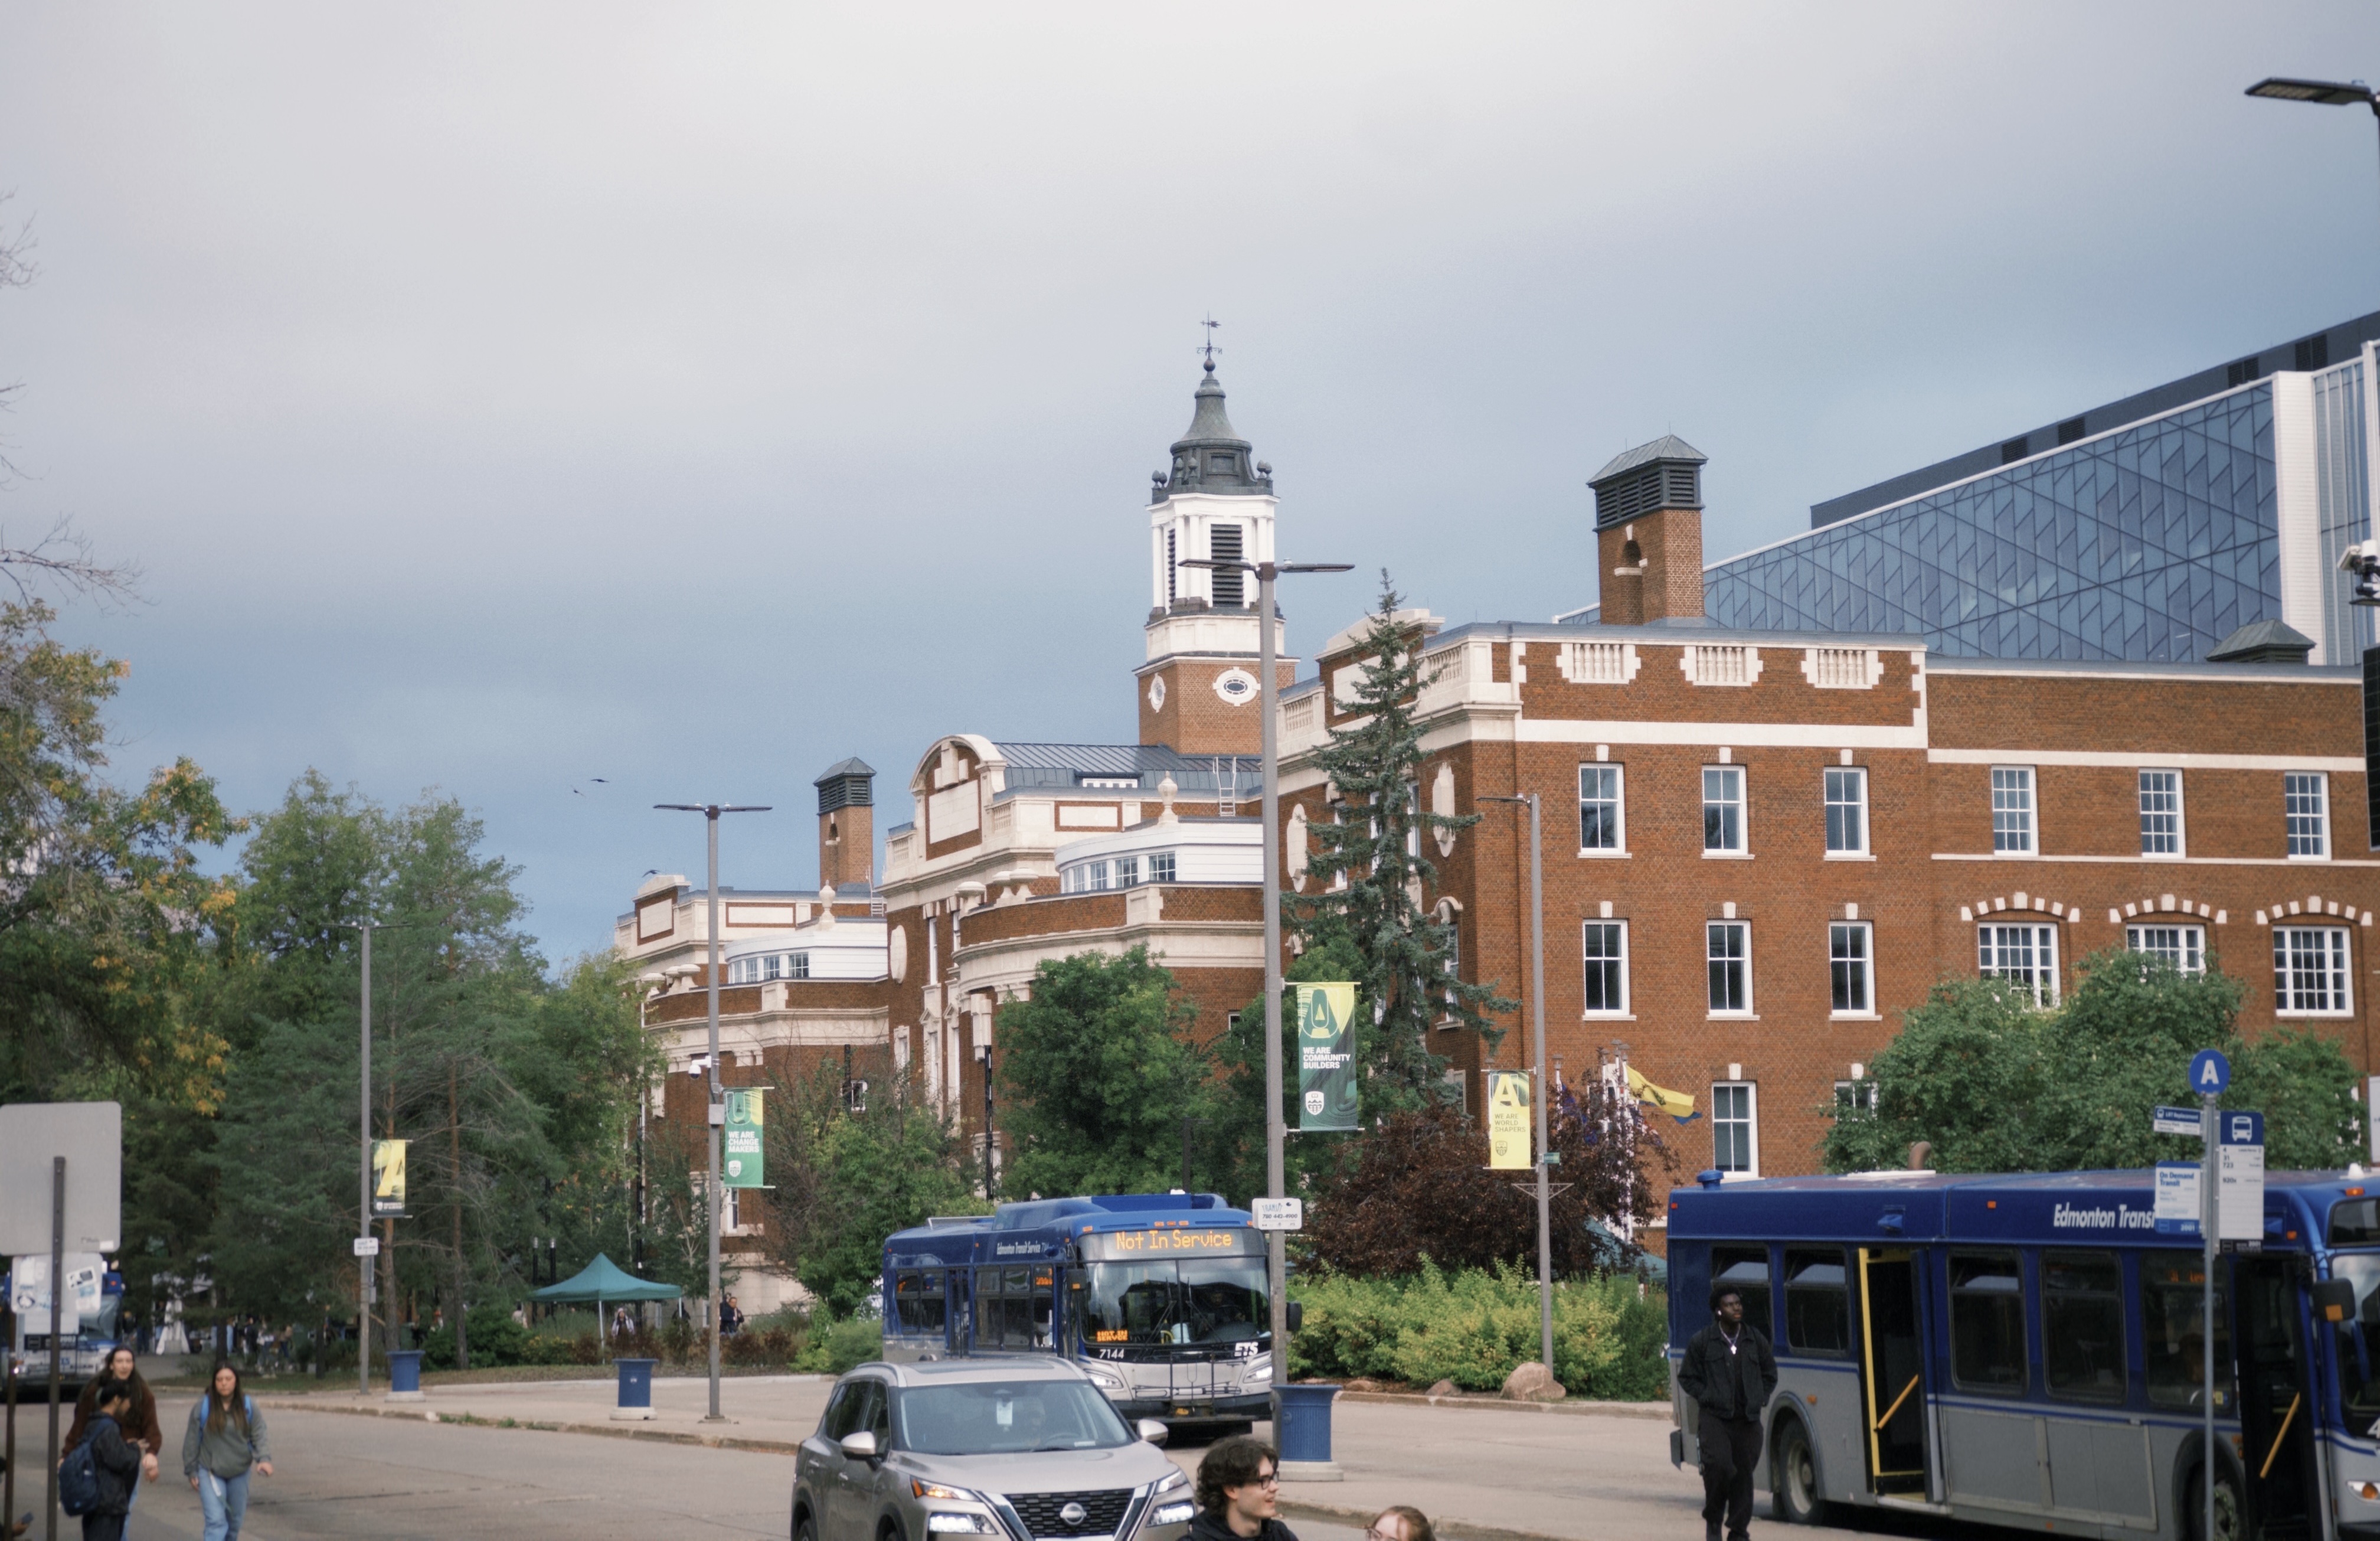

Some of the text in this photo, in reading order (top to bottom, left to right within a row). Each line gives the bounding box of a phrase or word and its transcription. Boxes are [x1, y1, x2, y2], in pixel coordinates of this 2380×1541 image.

[2201, 1060, 2219, 1085] A
[2054, 1202, 2116, 1228] Edmonton
[997, 1242, 1015, 1255] Edmonton
[1015, 1241, 1028, 1254] Transit
[1028, 1240, 1041, 1253] Service
[1116, 1229, 1232, 1250] Not In Service
[1100, 1349, 1124, 1359] 7144
[1234, 1342, 1258, 1356] ETS
